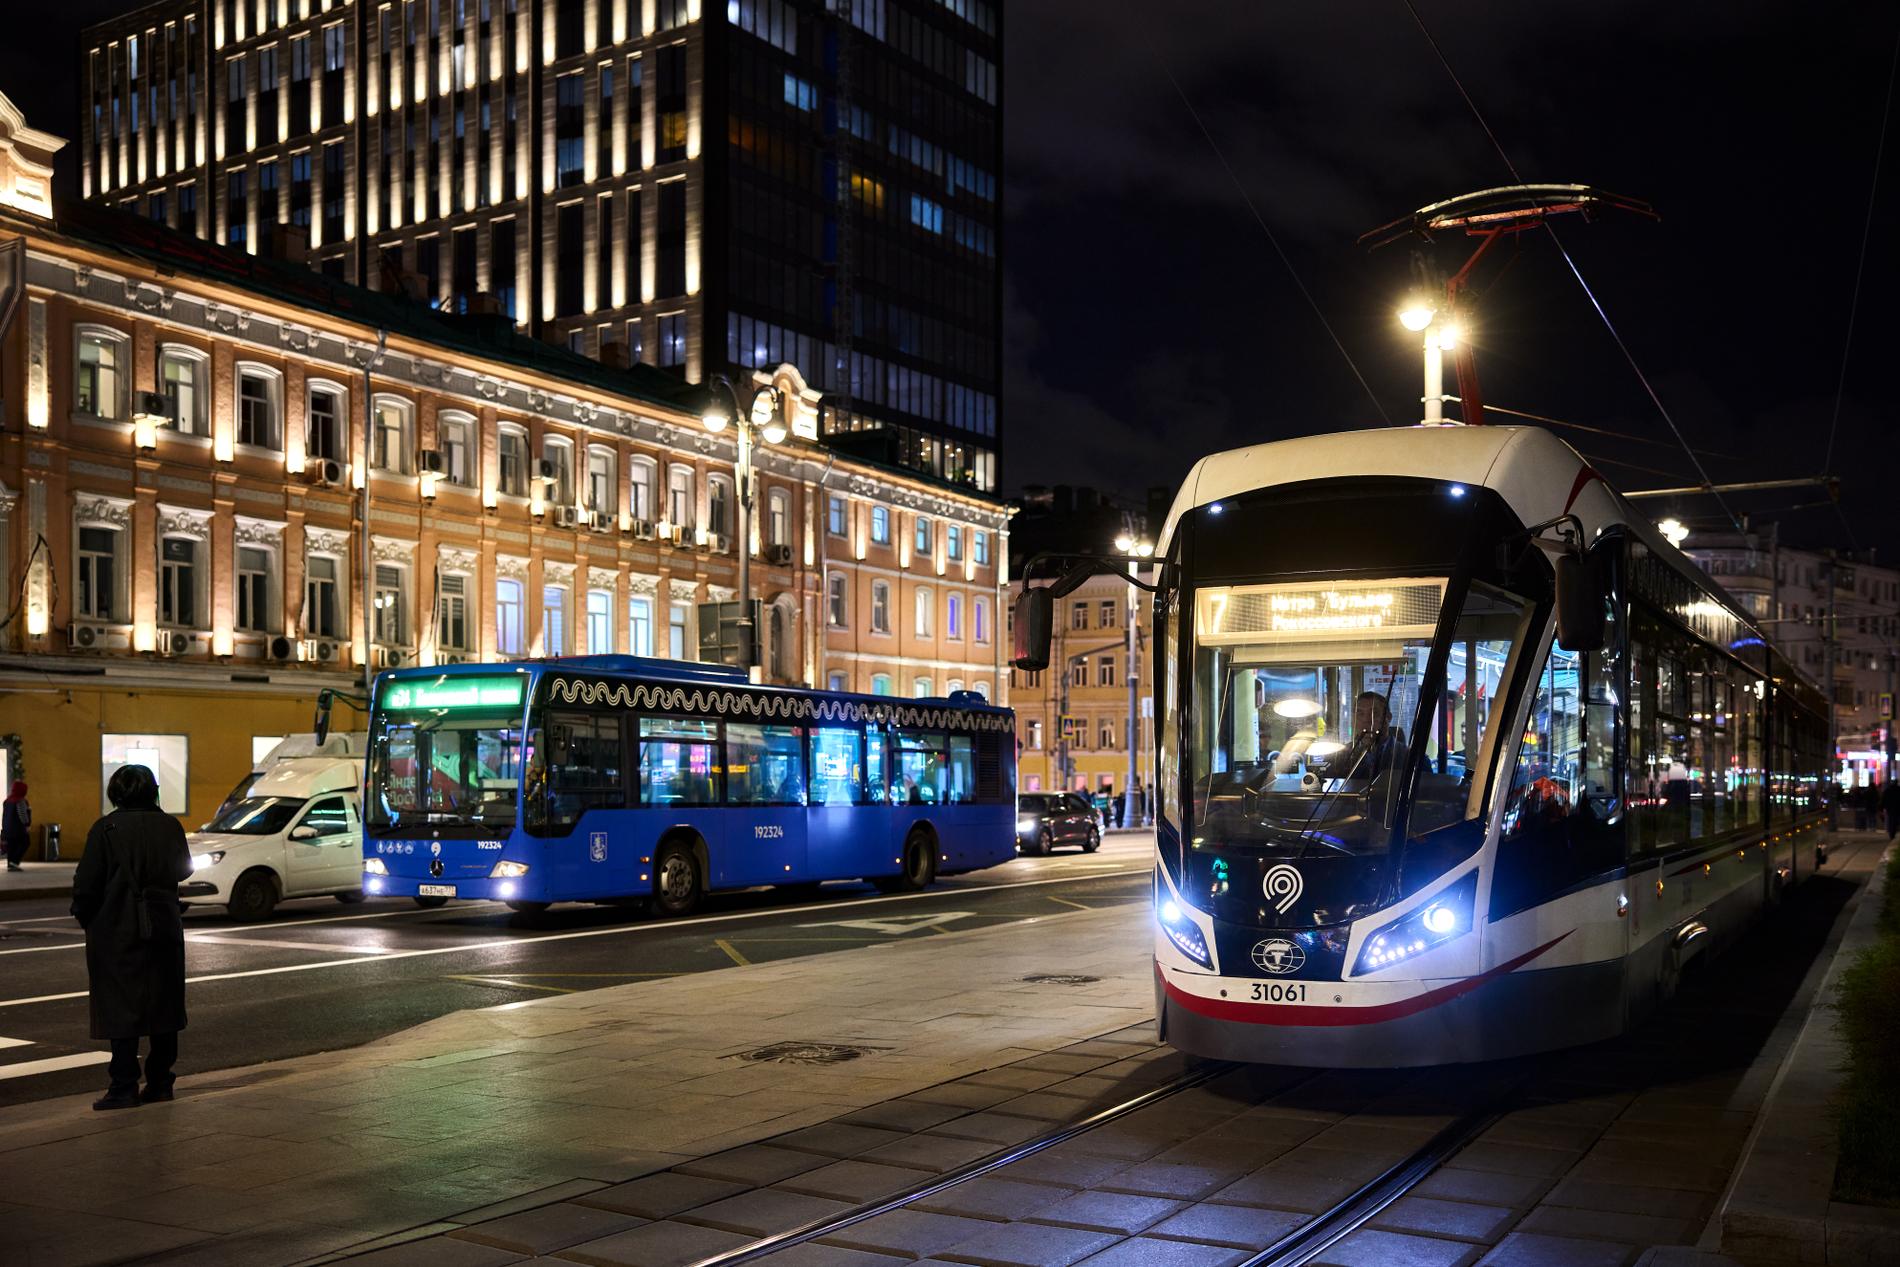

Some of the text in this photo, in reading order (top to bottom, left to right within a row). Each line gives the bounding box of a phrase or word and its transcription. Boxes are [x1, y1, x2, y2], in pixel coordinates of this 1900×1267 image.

[1210, 594, 1228, 634] 7
[754, 826, 784, 838] 192324
[477, 841, 502, 850] 192324
[1250, 983, 1306, 1002] 31061
